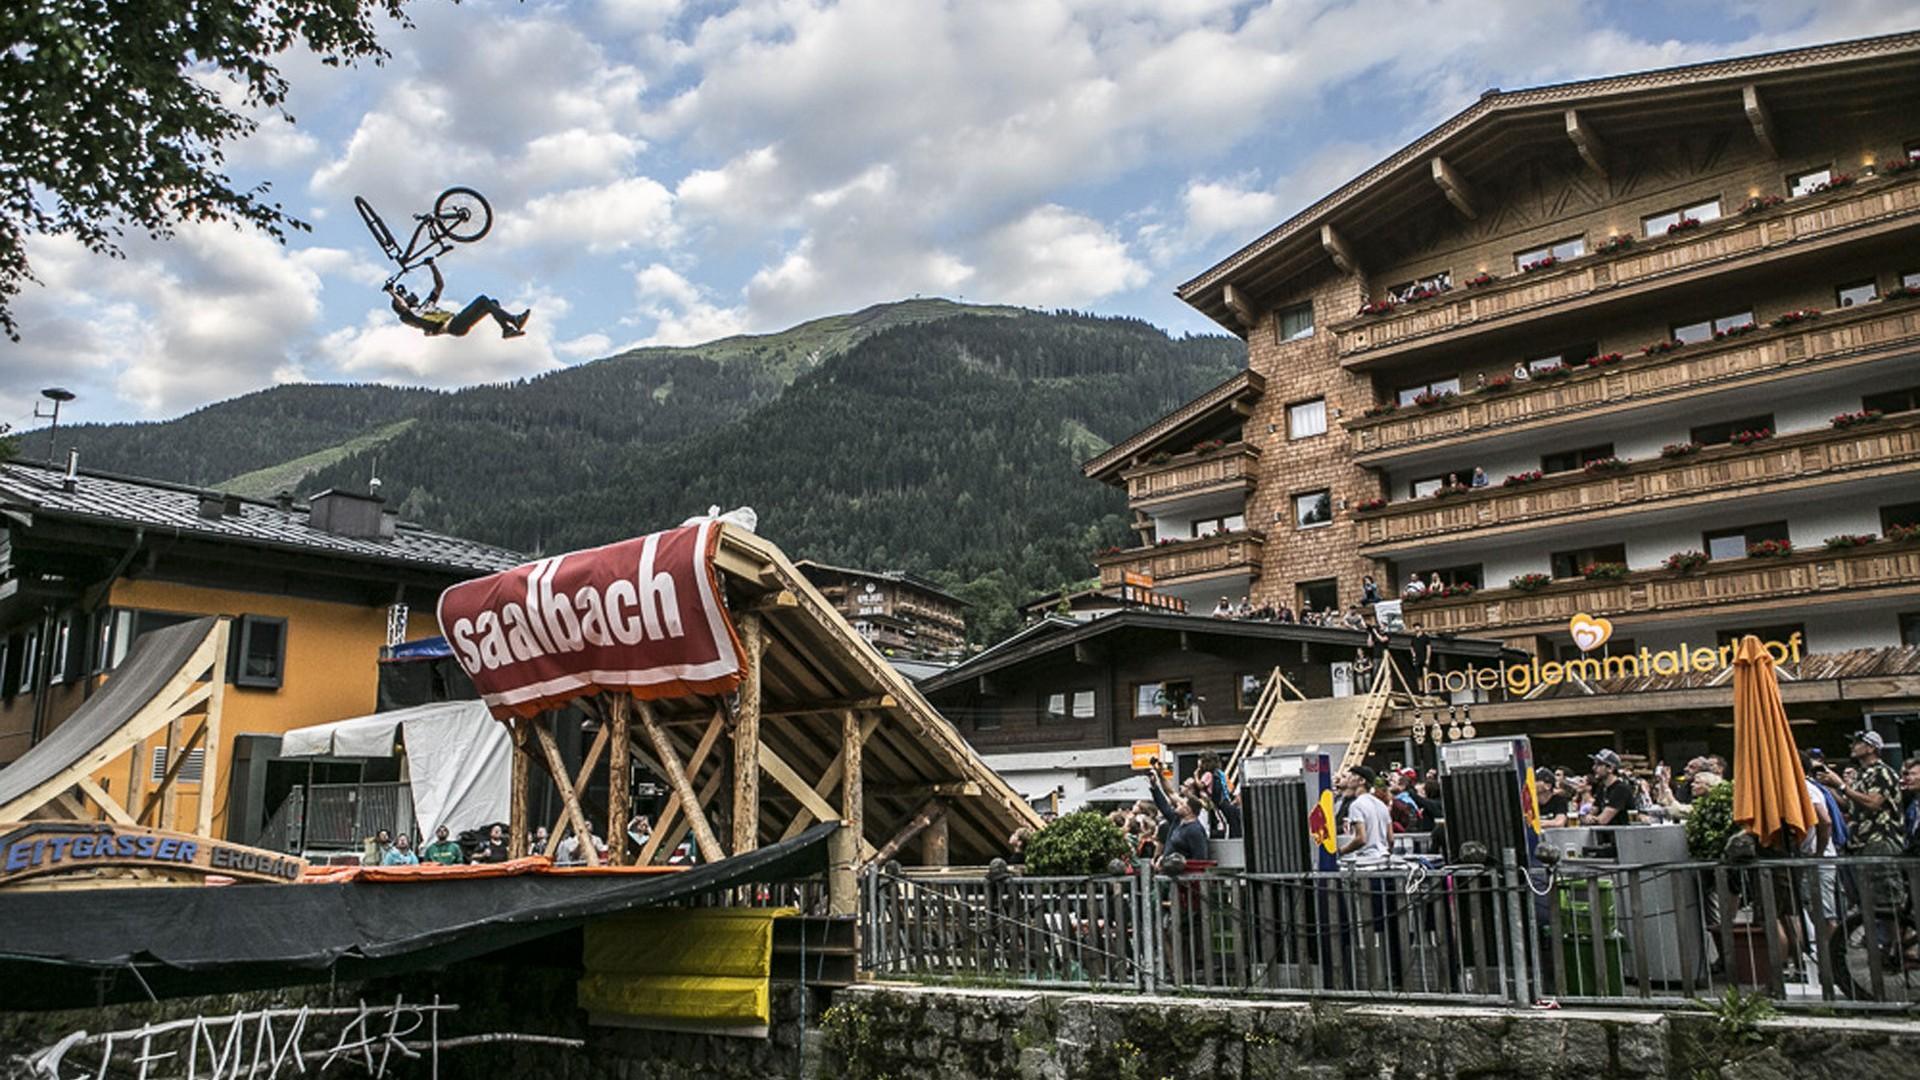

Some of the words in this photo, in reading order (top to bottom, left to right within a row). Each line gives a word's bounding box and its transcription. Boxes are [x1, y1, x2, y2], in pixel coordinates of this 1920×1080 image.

[453, 532, 684, 674] saalbach
[0, 833, 199, 872] EITGASSER
[212, 846, 299, 879] ERDBAU
